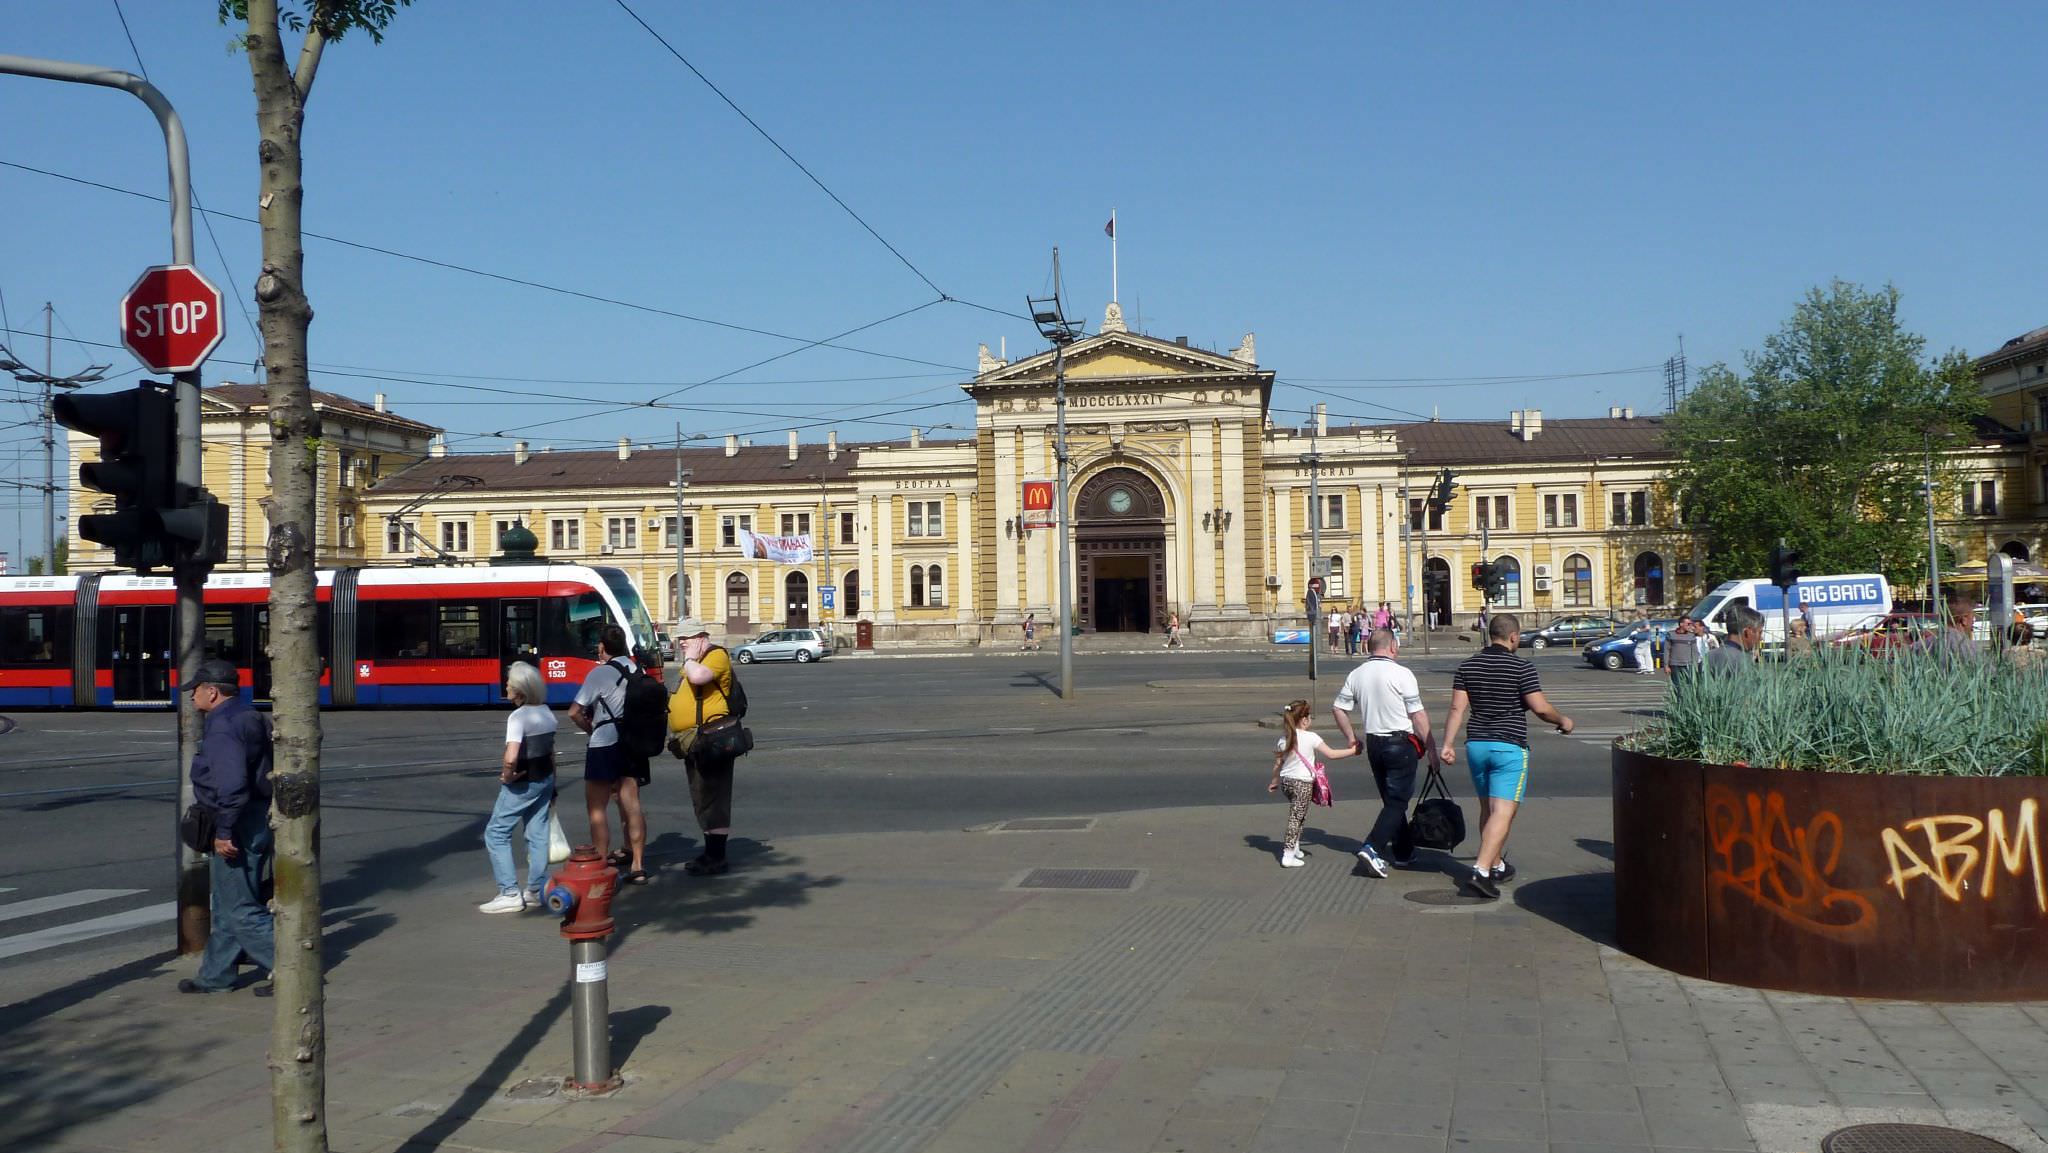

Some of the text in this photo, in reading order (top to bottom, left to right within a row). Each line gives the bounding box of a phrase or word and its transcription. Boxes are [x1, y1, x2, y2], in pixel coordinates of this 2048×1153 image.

[134, 300, 208, 338] STOP
[1069, 394, 1164, 408] MDCCCLXXXIV
[1295, 467, 1354, 477] BEGRAD
[895, 479, 952, 489] БЕОГРАД
[1798, 583, 1877, 603] BIG BANG
[548, 670, 566, 678] 1520
[1880, 797, 2048, 914] ABM
